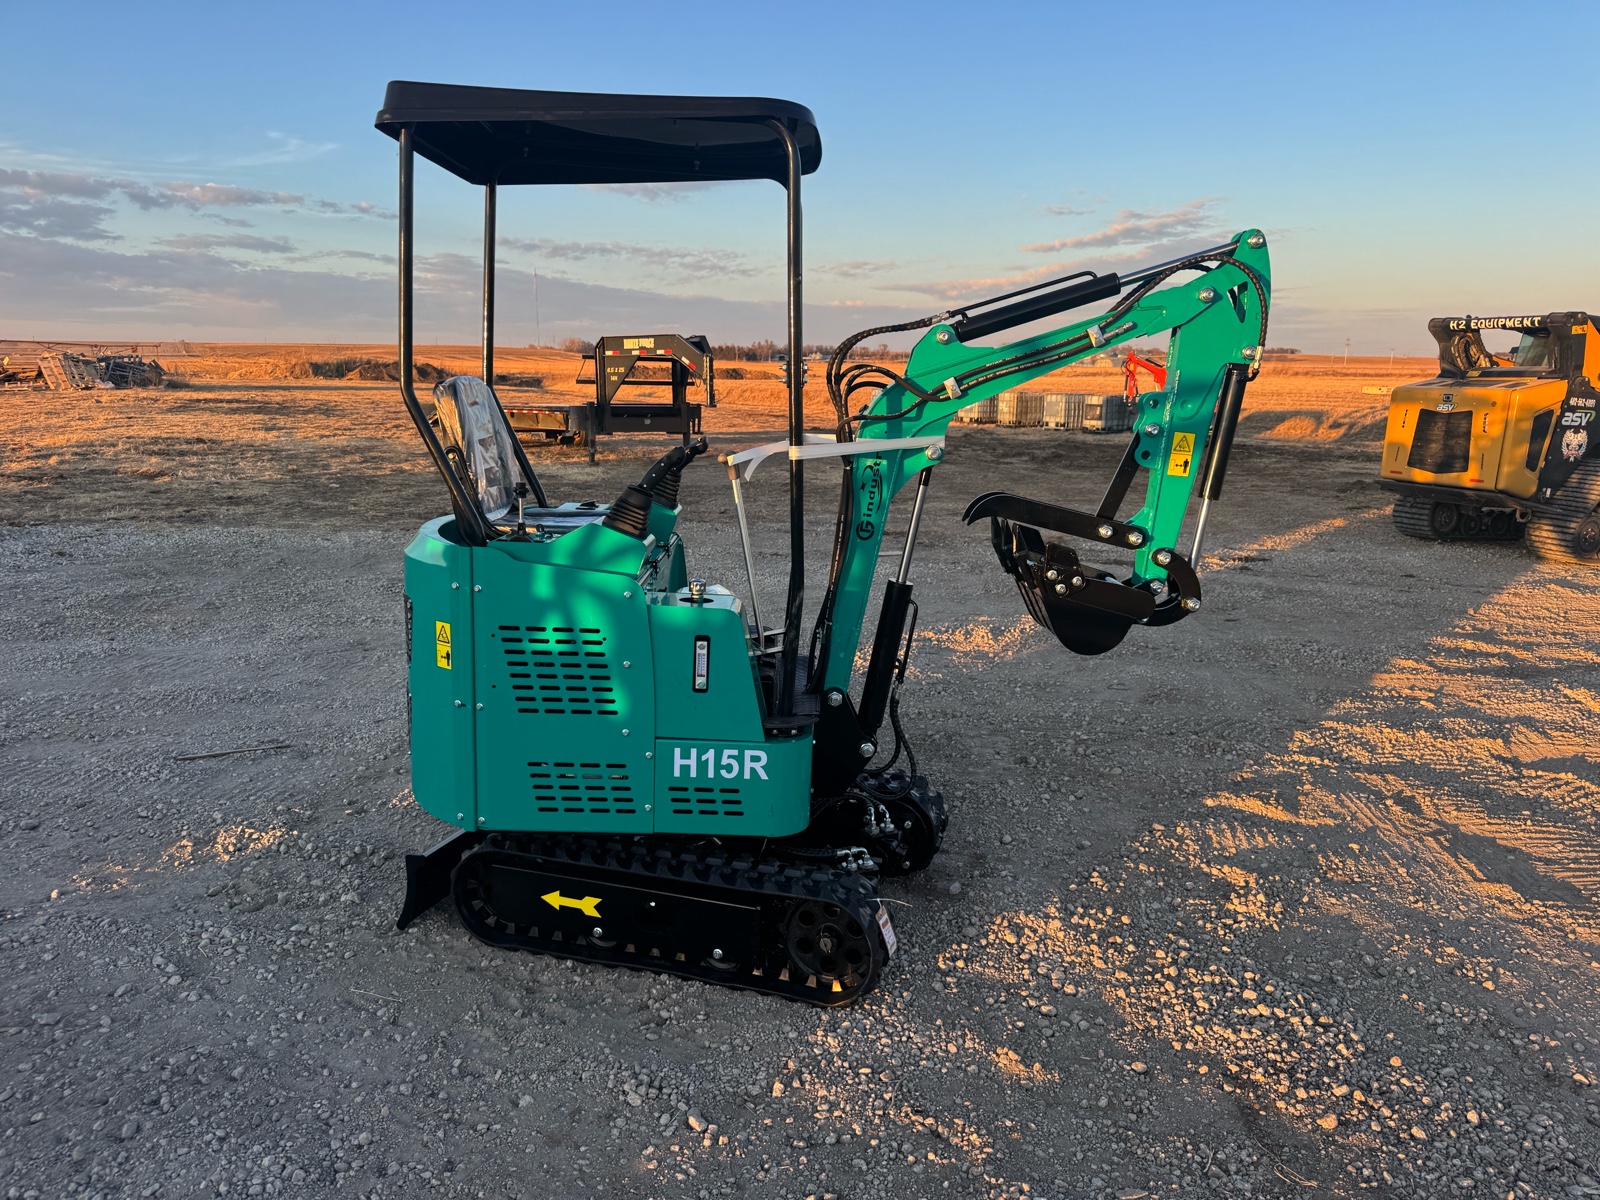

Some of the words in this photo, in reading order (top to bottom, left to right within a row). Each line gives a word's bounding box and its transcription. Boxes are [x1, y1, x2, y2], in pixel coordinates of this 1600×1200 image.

[1450, 320, 1466, 330] H2
[1470, 316, 1541, 330] EQUIPMENT
[856, 451, 882, 540] Gindustr
[673, 748, 769, 780] H15R
